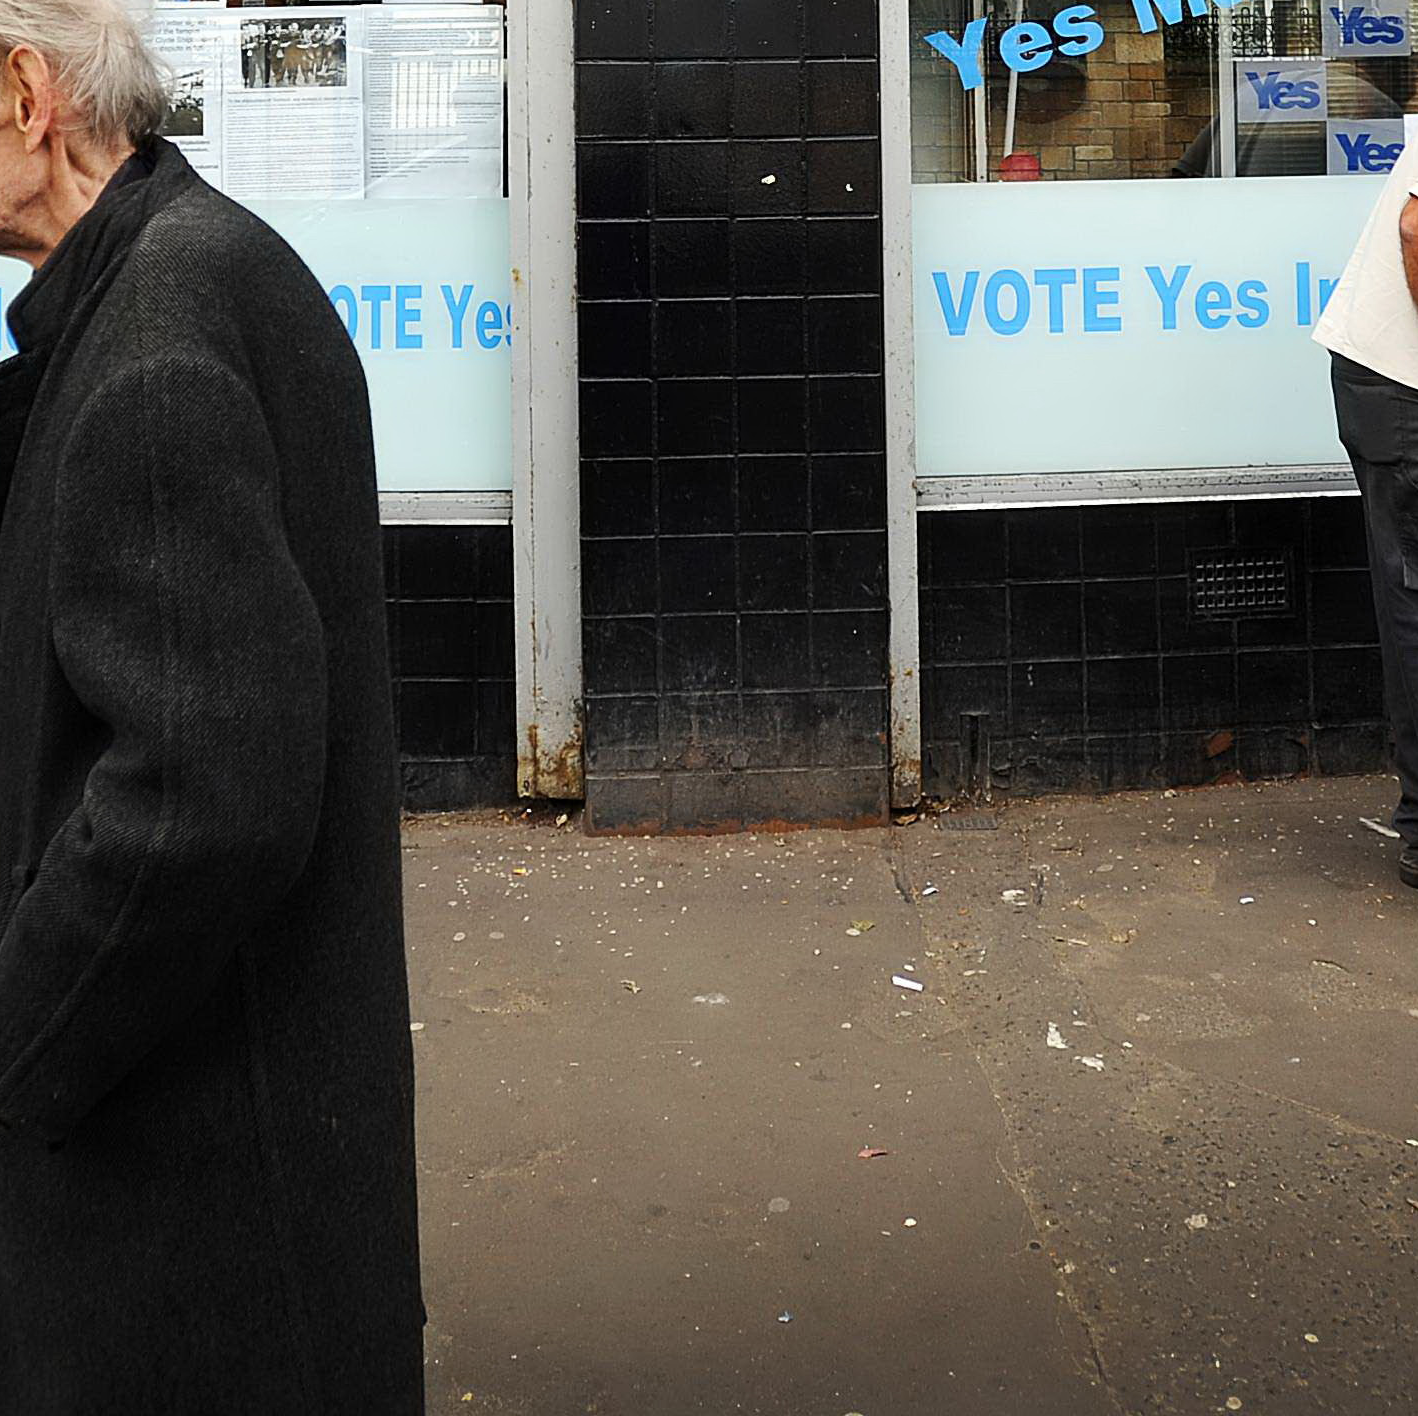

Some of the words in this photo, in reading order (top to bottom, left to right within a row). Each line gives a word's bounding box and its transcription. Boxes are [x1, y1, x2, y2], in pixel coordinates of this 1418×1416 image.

[924, 2, 1104, 91] Yes
[1330, 6, 1404, 45] Yes
[1244, 71, 1321, 110] Yes
[1335, 134, 1406, 172] Yes
[329, 285, 423, 349] OTE
[932, 266, 1122, 336] VOTE
[1144, 265, 1270, 331] Yes
